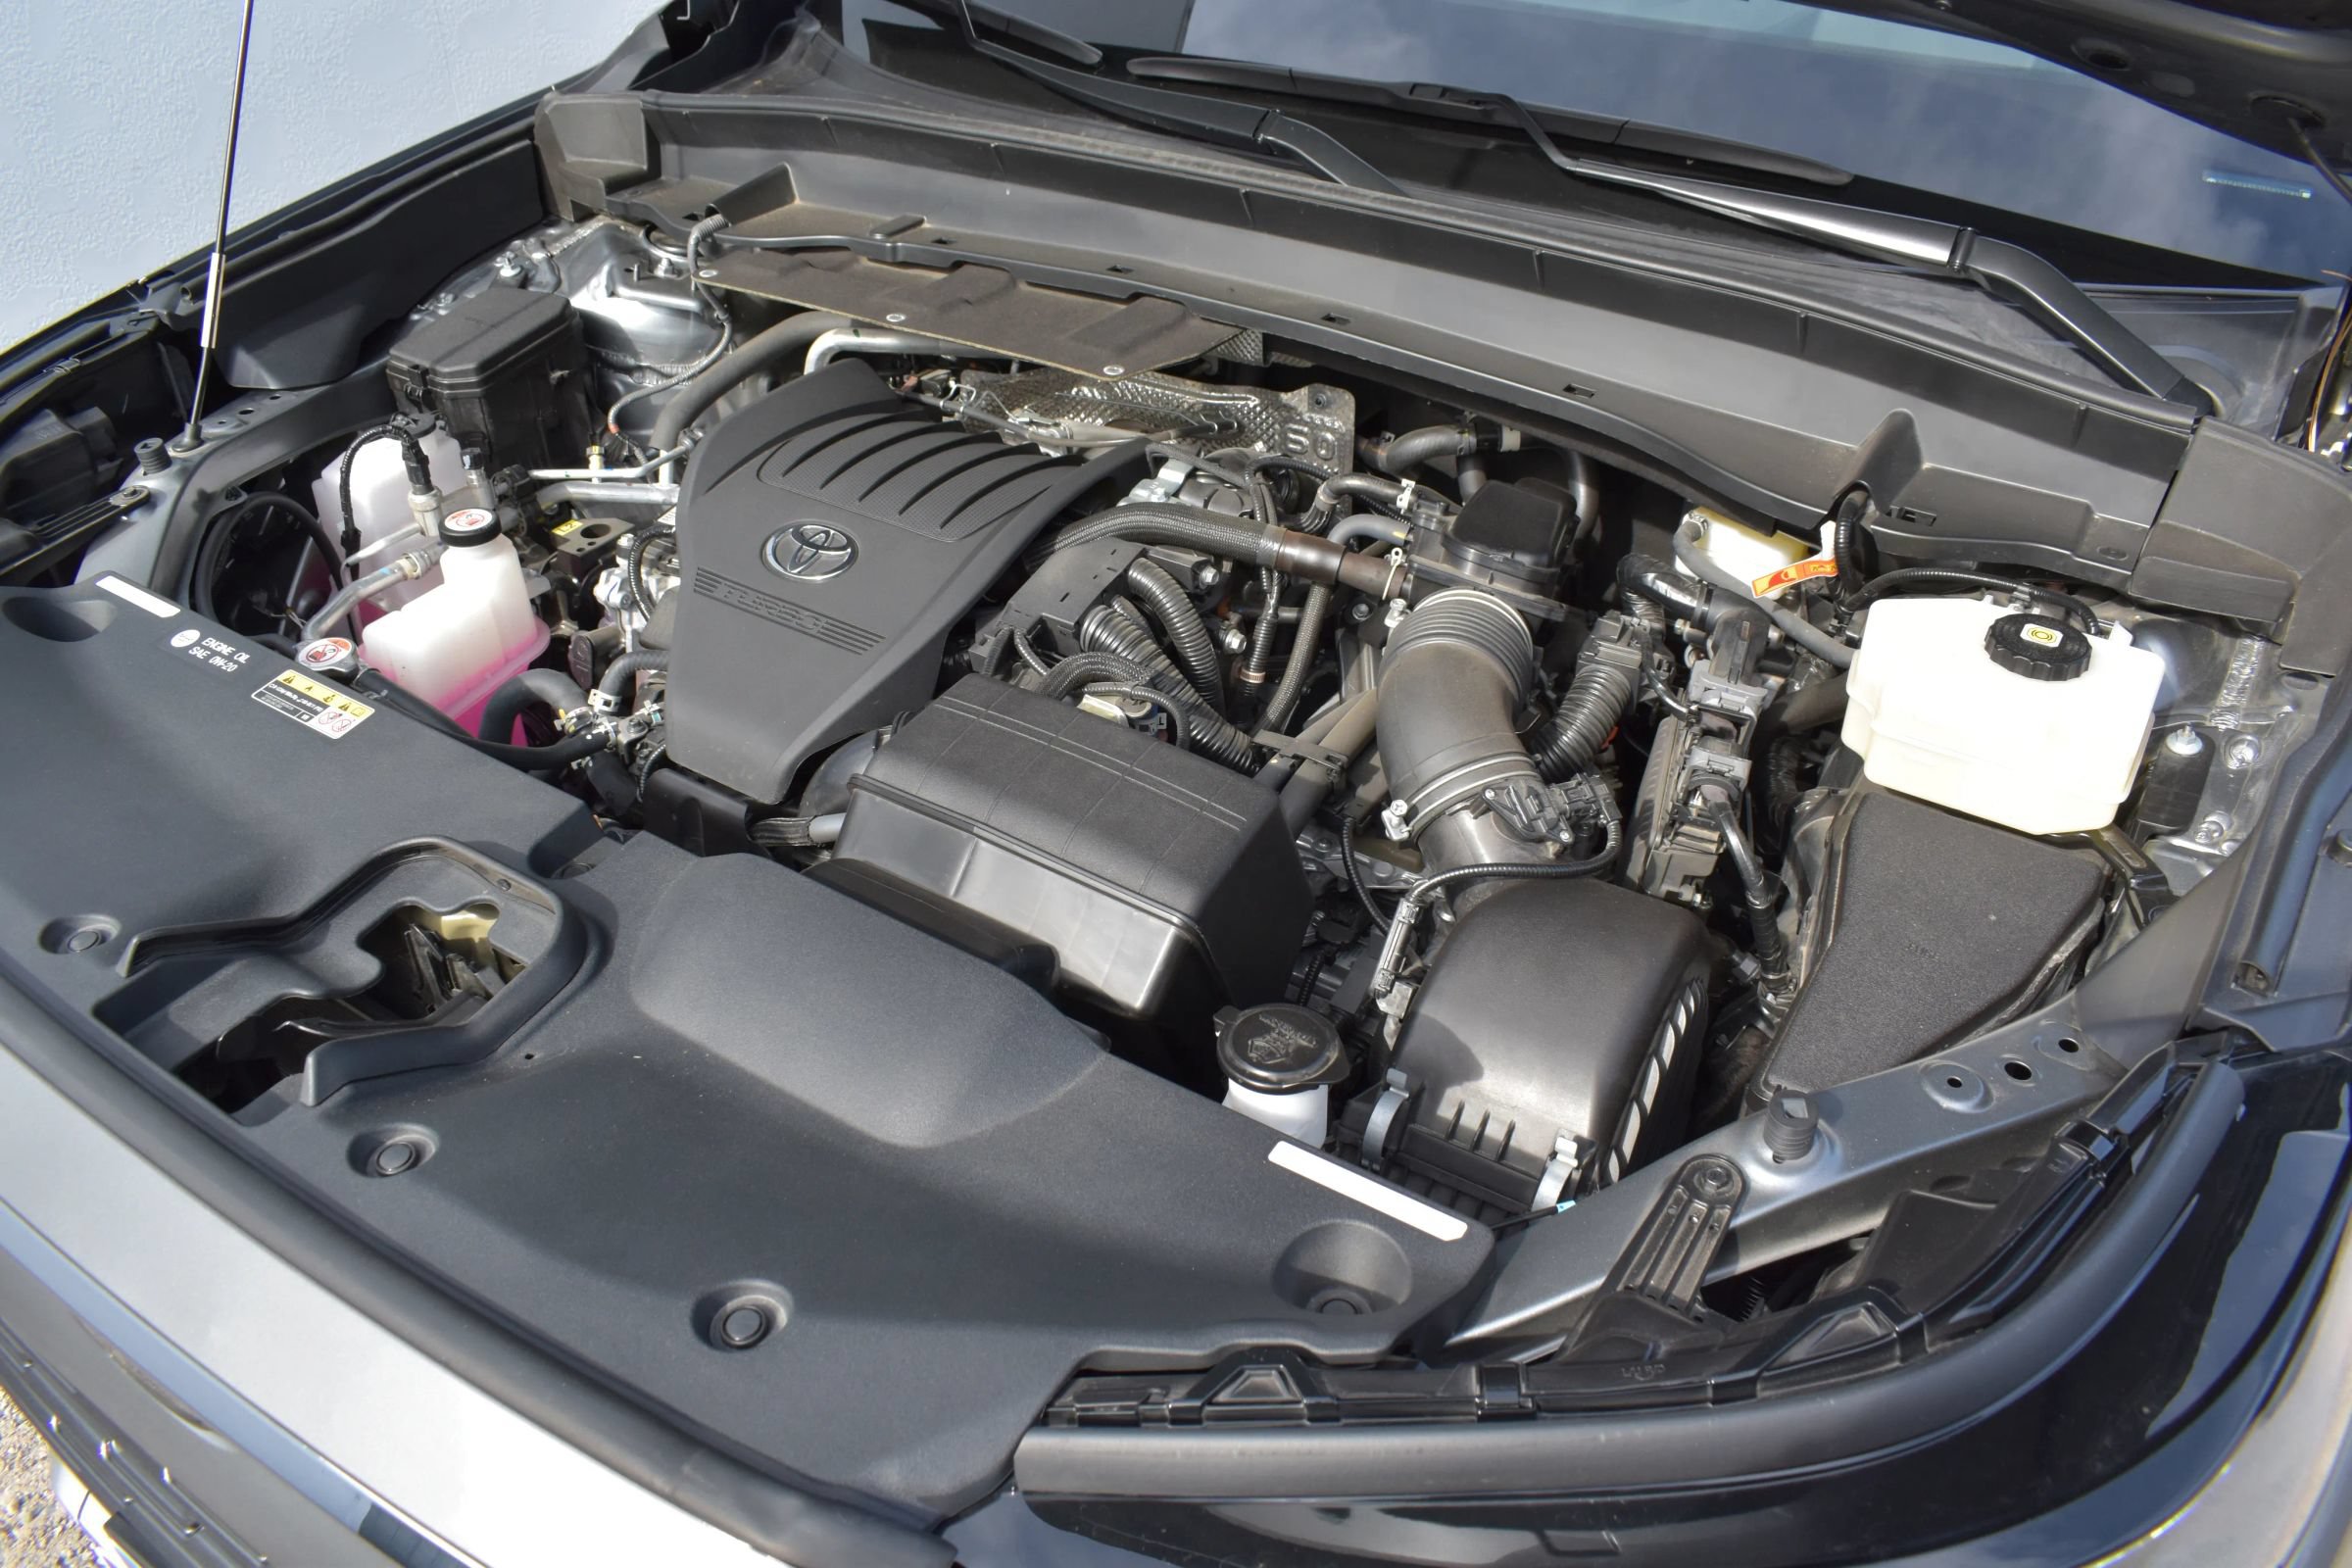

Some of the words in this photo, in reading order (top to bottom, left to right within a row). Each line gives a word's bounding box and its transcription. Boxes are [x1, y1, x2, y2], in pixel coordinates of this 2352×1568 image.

[723, 583, 823, 630] TURBO
[188, 646, 211, 660] SAE
[208, 656, 238, 672] 0W-20
[201, 637, 236, 656] ENGINE
[233, 652, 251, 664] OIL
